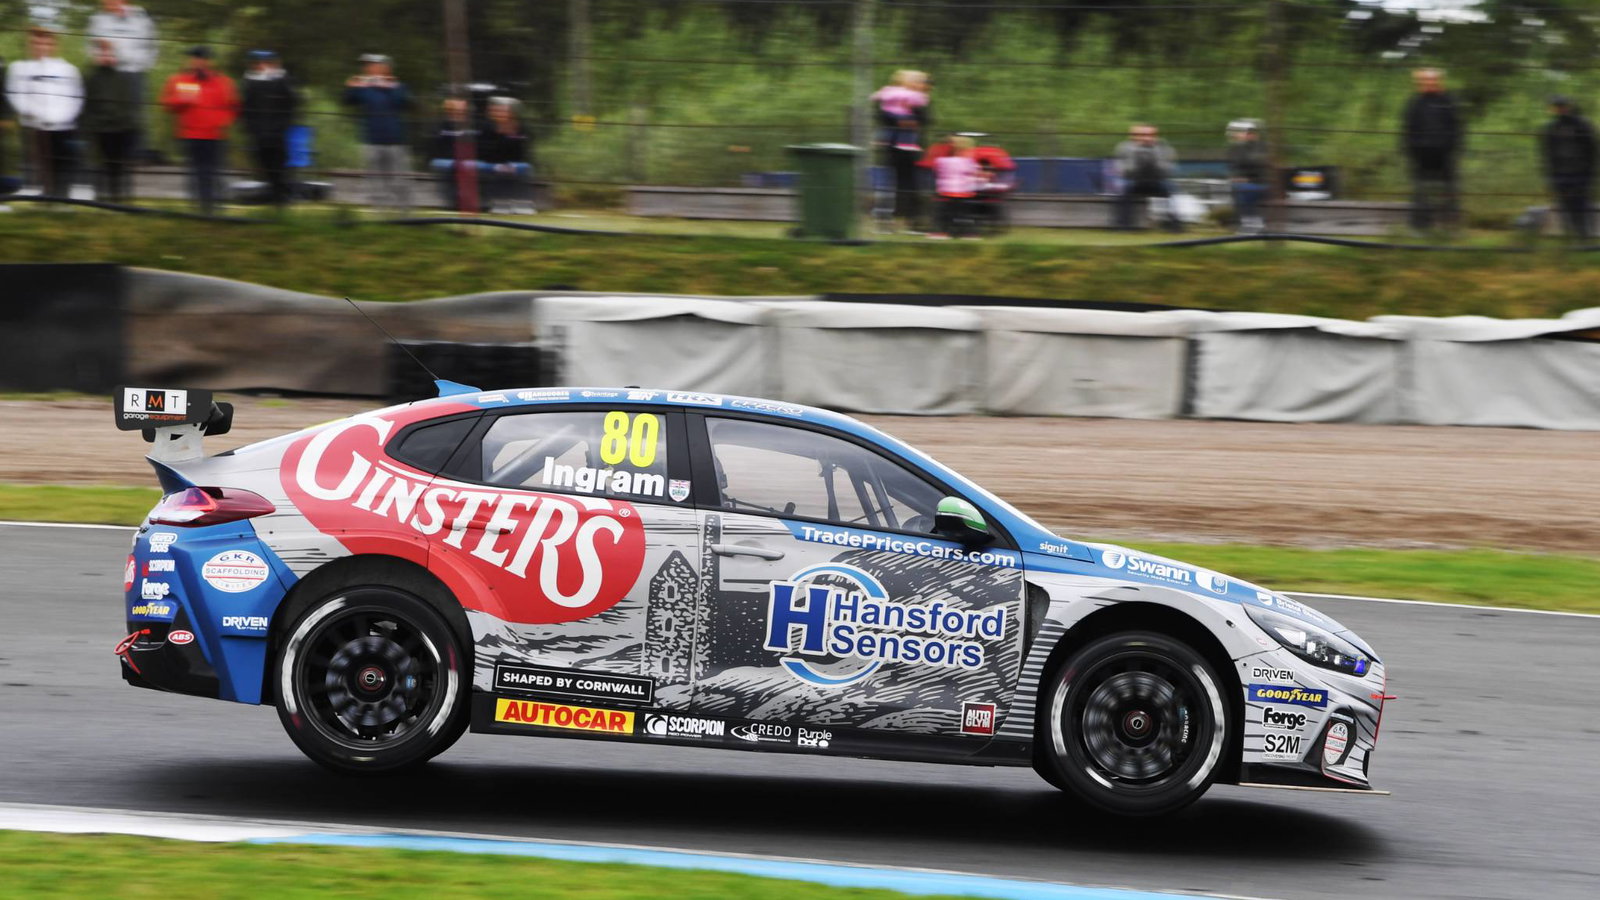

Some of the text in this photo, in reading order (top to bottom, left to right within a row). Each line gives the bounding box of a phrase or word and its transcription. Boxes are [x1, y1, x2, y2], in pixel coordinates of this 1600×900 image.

[600, 411, 659, 468] 80
[542, 456, 665, 497] Ingram
[296, 415, 625, 608] GINSTERS
[801, 526, 1015, 568] TradePriceCars.com
[219, 553, 255, 563] GKR
[205, 567, 266, 576] SCAFFOLDING
[1127, 555, 1192, 583] Swann
[132, 603, 170, 616] GOODYEAR
[833, 593, 1004, 637] Hansford
[222, 616, 268, 629] DRIVEN
[171, 632, 191, 641] ABS
[830, 625, 982, 668] Sensors
[503, 672, 645, 696] SHAPED BY CORNWALL
[1253, 668, 1294, 681] DRIVEN
[1257, 688, 1322, 703] GOODYEAR
[503, 701, 627, 731] AUTOCAR
[668, 715, 725, 736] SCORPION
[750, 723, 792, 737] CREDO
[798, 728, 832, 740] Purple
[1265, 734, 1300, 754] S2M
